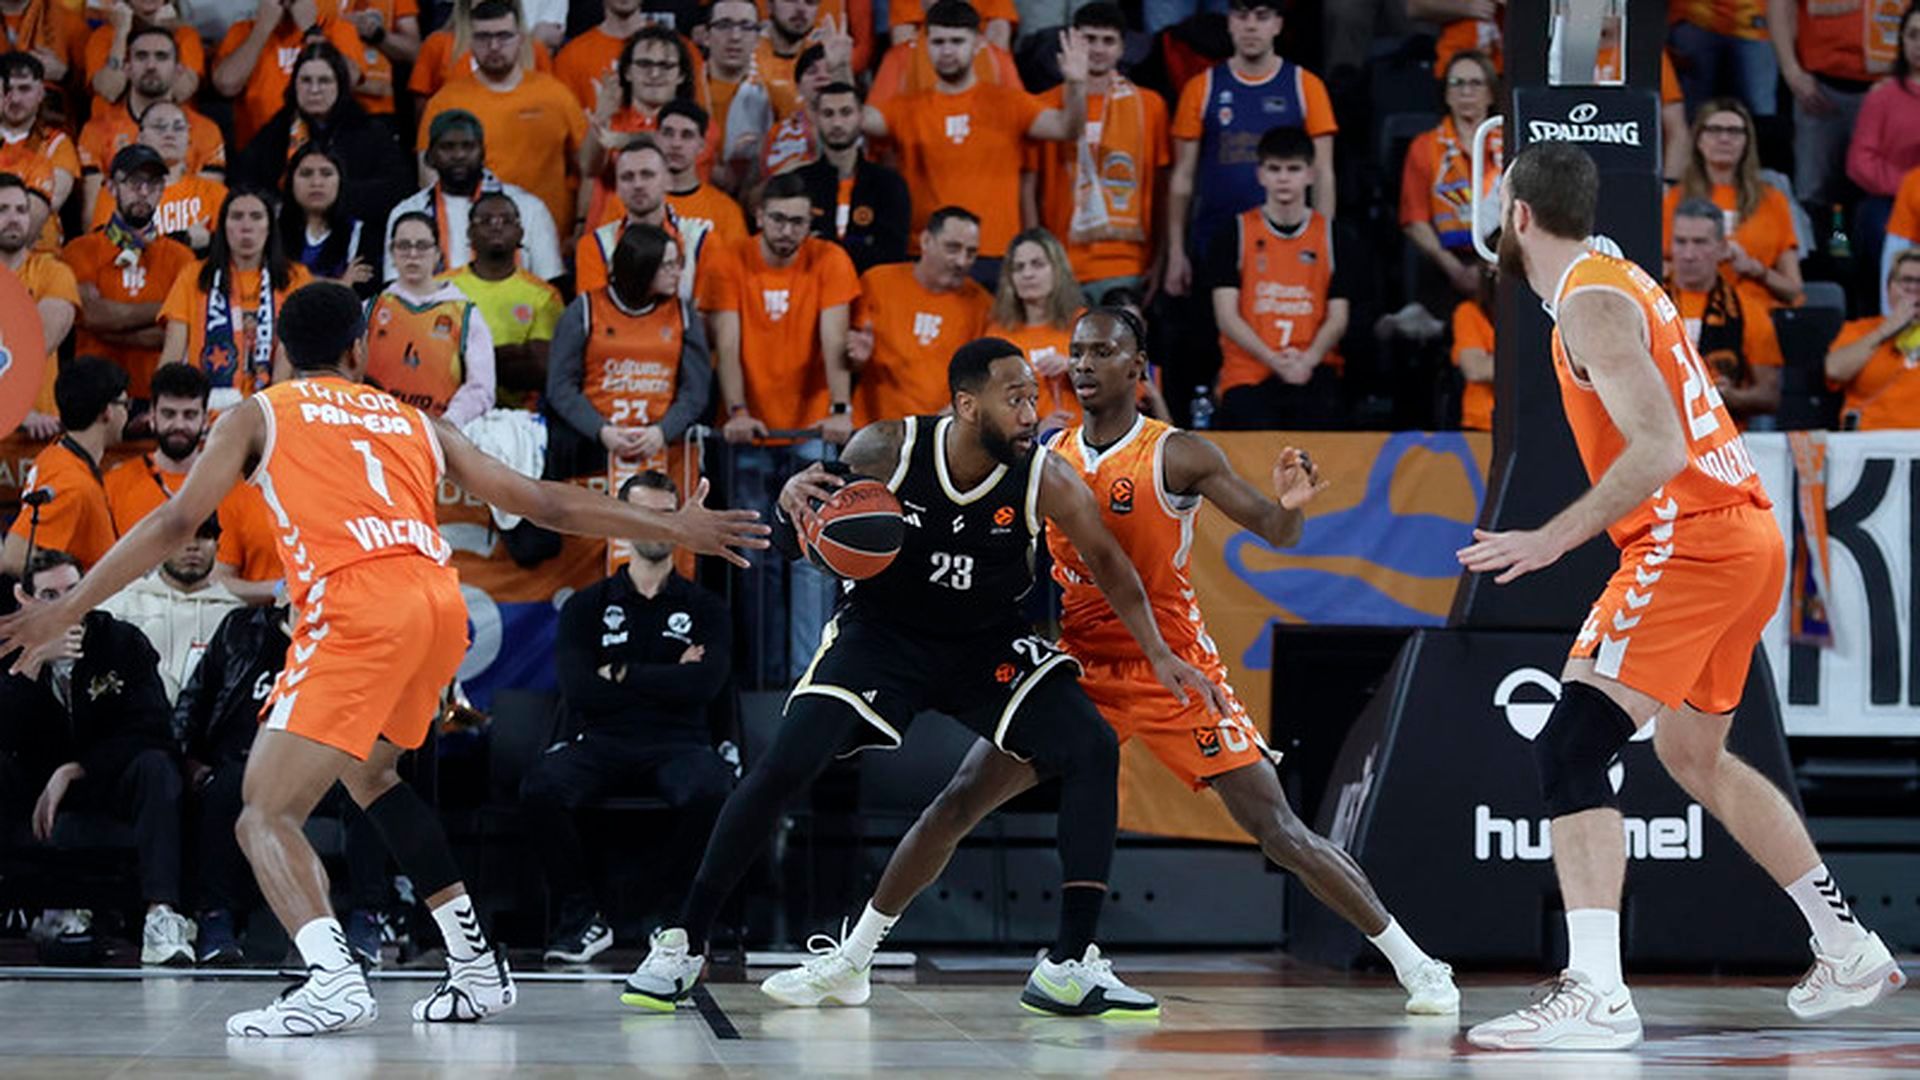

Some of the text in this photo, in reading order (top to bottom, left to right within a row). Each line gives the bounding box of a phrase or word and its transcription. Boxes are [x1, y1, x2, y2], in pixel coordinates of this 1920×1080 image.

[1528, 120, 1641, 145] SPALDING
[1275, 320, 1294, 347] 7
[351, 440, 394, 506] 1
[929, 551, 974, 590] 23
[1475, 804, 1702, 860] humel
